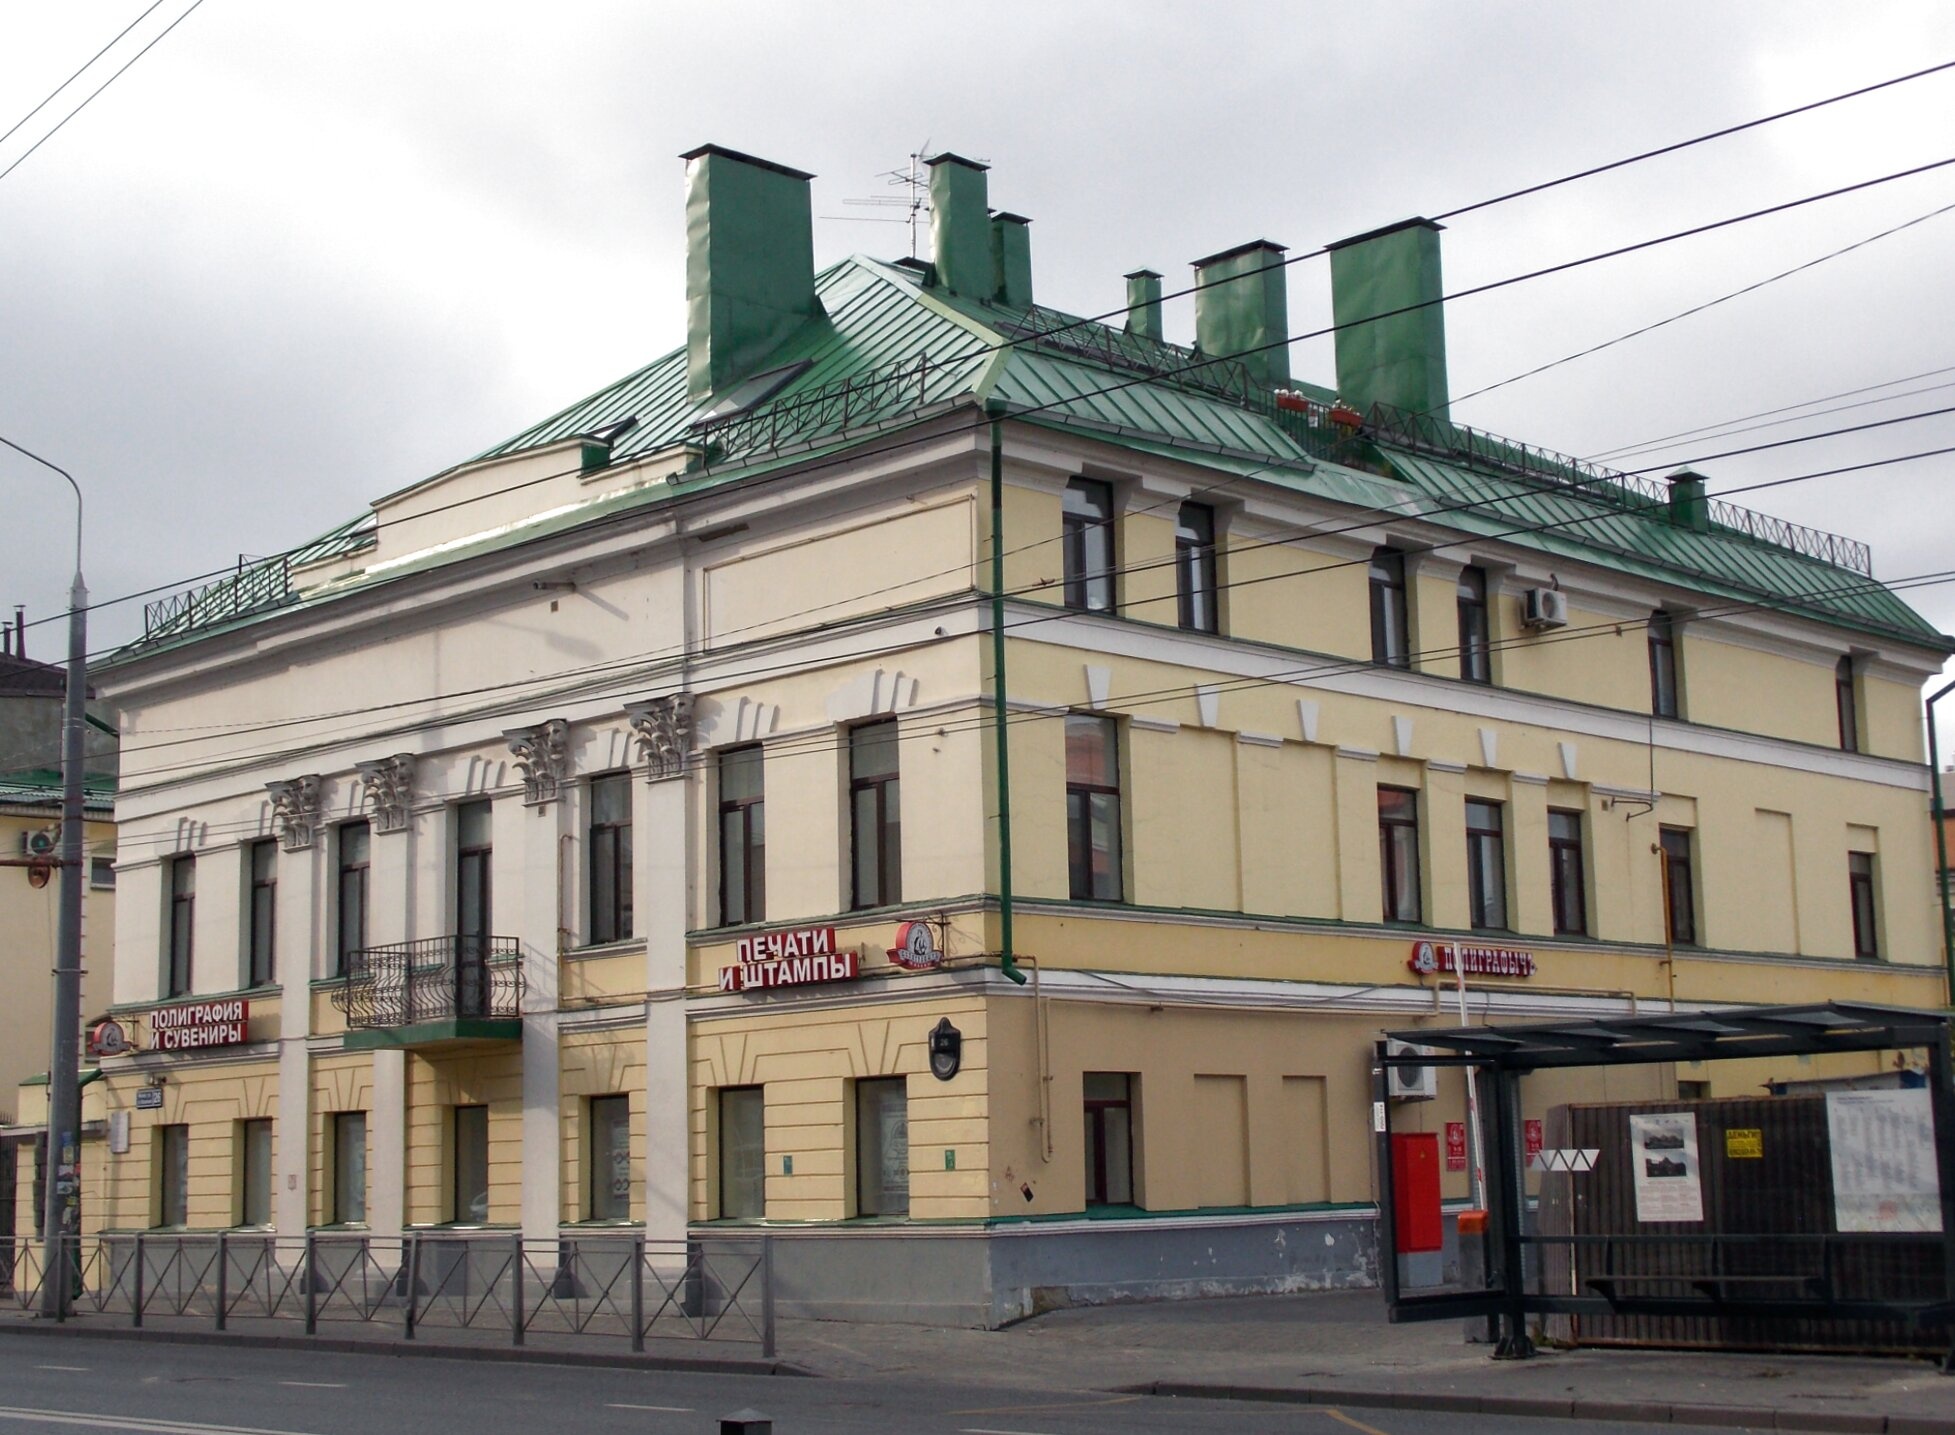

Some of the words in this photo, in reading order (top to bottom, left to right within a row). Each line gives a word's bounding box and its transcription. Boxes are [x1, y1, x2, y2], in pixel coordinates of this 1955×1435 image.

[737, 929, 829, 962] ПЕЧАТИ
[719, 968, 734, 991] И
[743, 953, 850, 988] ШТАМПЫ
[150, 1002, 242, 1028] ПОЛИГРАФИЯ
[151, 1032, 160, 1049] И
[164, 1023, 241, 1048] СУВЕНИРЫ
